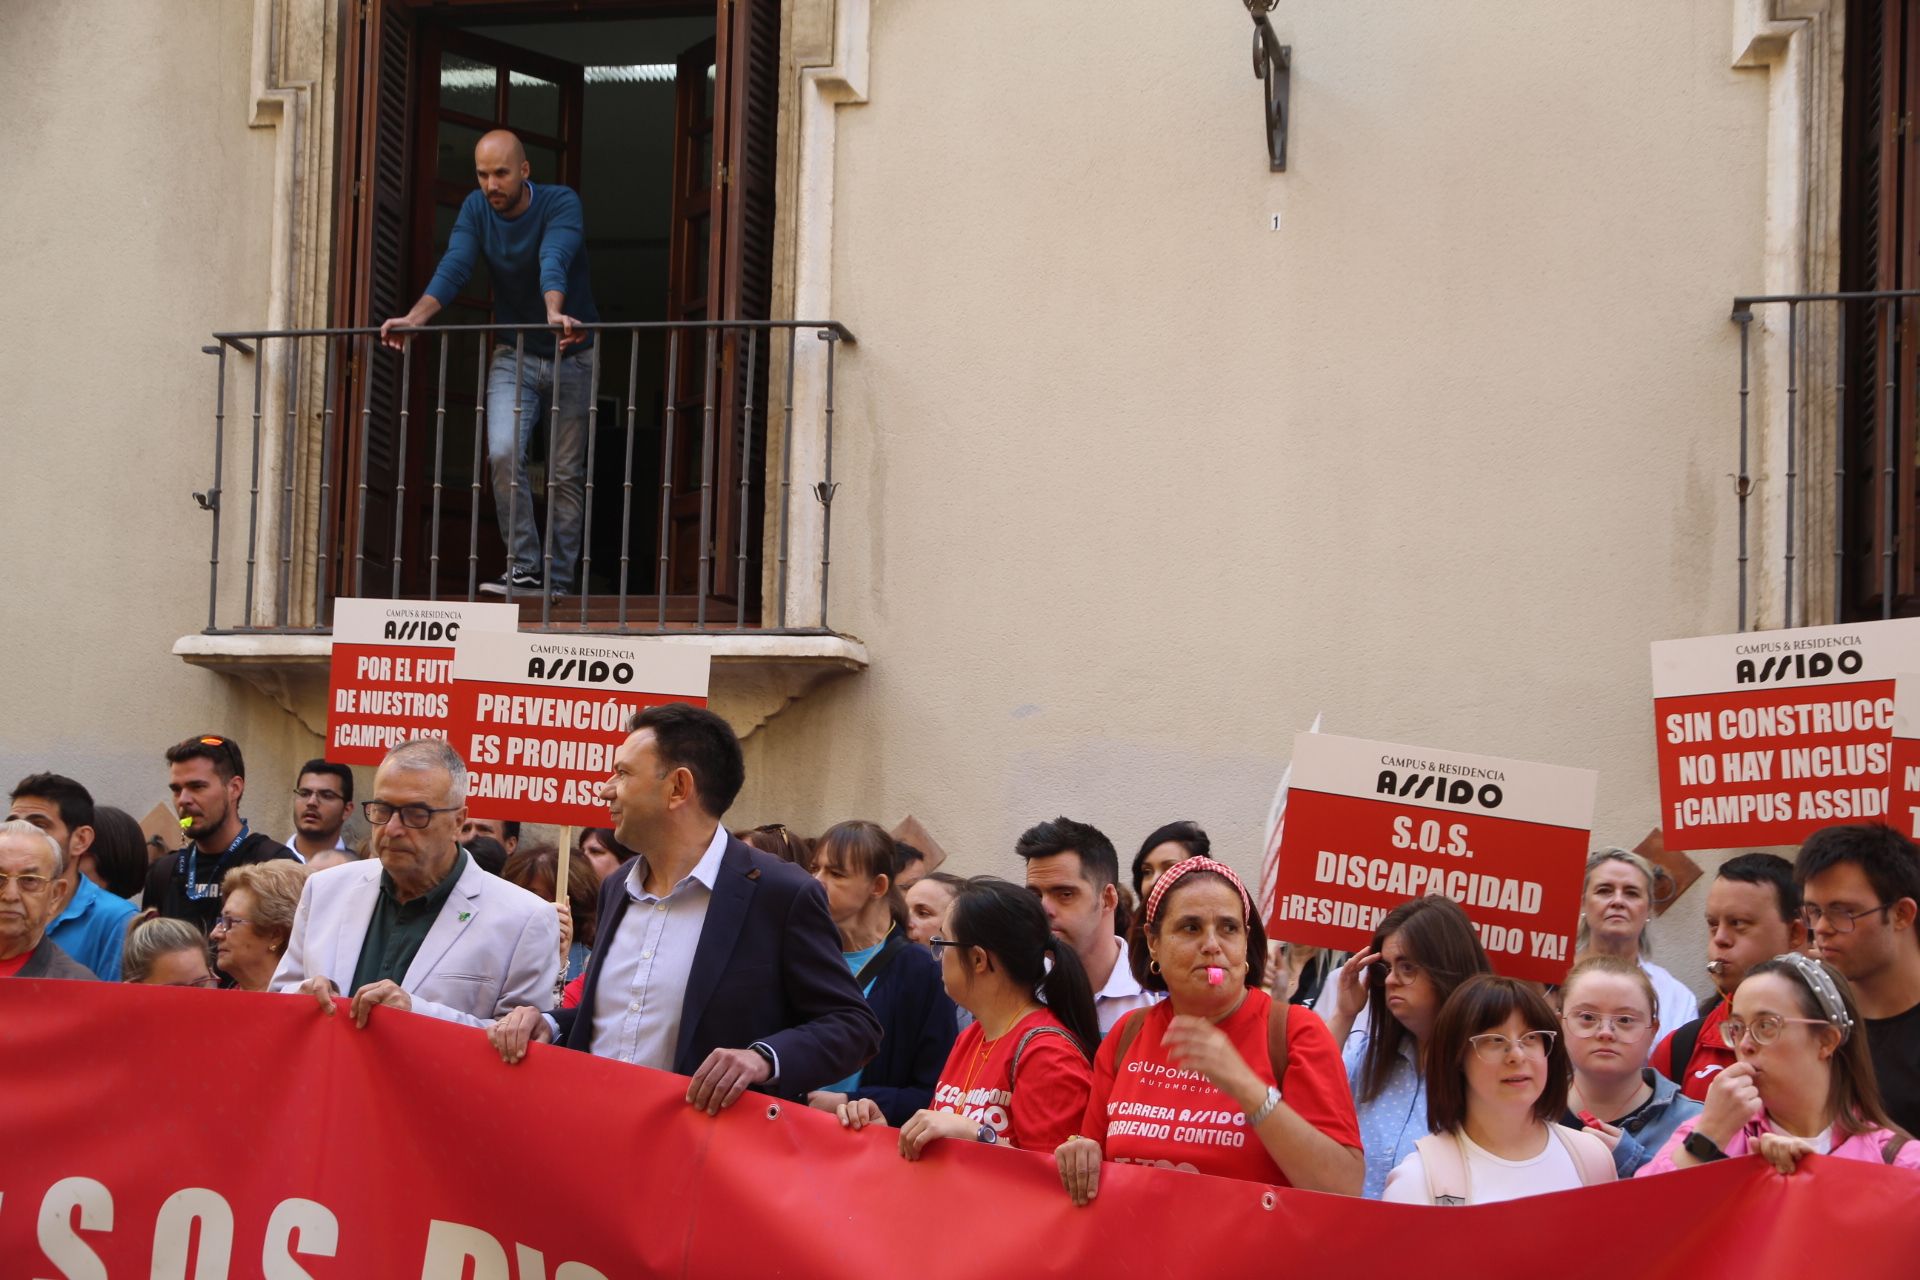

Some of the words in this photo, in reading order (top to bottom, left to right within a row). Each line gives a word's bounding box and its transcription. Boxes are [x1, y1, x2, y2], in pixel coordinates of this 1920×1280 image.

[1273, 215, 1279, 230] 1
[386, 609, 414, 618] CAMPUS
[420, 609, 462, 620] RESIDENCIA
[530, 644, 569, 656] CAMPUS
[570, 647, 577, 656] &
[579, 647, 635, 660] RESIDENCIA
[1735, 641, 1781, 655] CAMPUS
[1783, 641, 1791, 651] &
[1793, 635, 1862, 650] RESIDENCIA
[357, 655, 392, 681] POR
[395, 657, 412, 682] EL
[528, 657, 634, 685] ASSIDO
[1736, 649, 1863, 684] ASSIDO
[335, 688, 357, 713] DE
[359, 690, 449, 719] NUESTROS
[1666, 711, 1713, 745] SIN
[1718, 697, 1894, 741] CONSTRUCC
[469, 733, 501, 765] ES
[506, 736, 622, 774] PROHIBI
[1381, 755, 1427, 771] CAMPUS
[1428, 762, 1436, 772] &
[1438, 763, 1505, 781] RESIDENCIA
[1679, 754, 1717, 786] NO
[1722, 750, 1775, 784] HAY
[561, 778, 612, 808] ASS
[1376, 770, 1503, 809] ASSIDO
[1674, 791, 1793, 830] ¡CAMPUS
[1391, 815, 1474, 859] S.O.S.
[1315, 850, 1543, 915] DISCAPACIDAD
[1280, 894, 1391, 932] ¡RESIDEN
[1530, 931, 1568, 961] YA!
[1140, 1077, 1219, 1094] AUTOMOCIÓN
[1118, 1102, 1176, 1121] CARRERA
[1178, 1108, 1247, 1127] ASSIDO
[1173, 1126, 1246, 1148] CONTIGO
